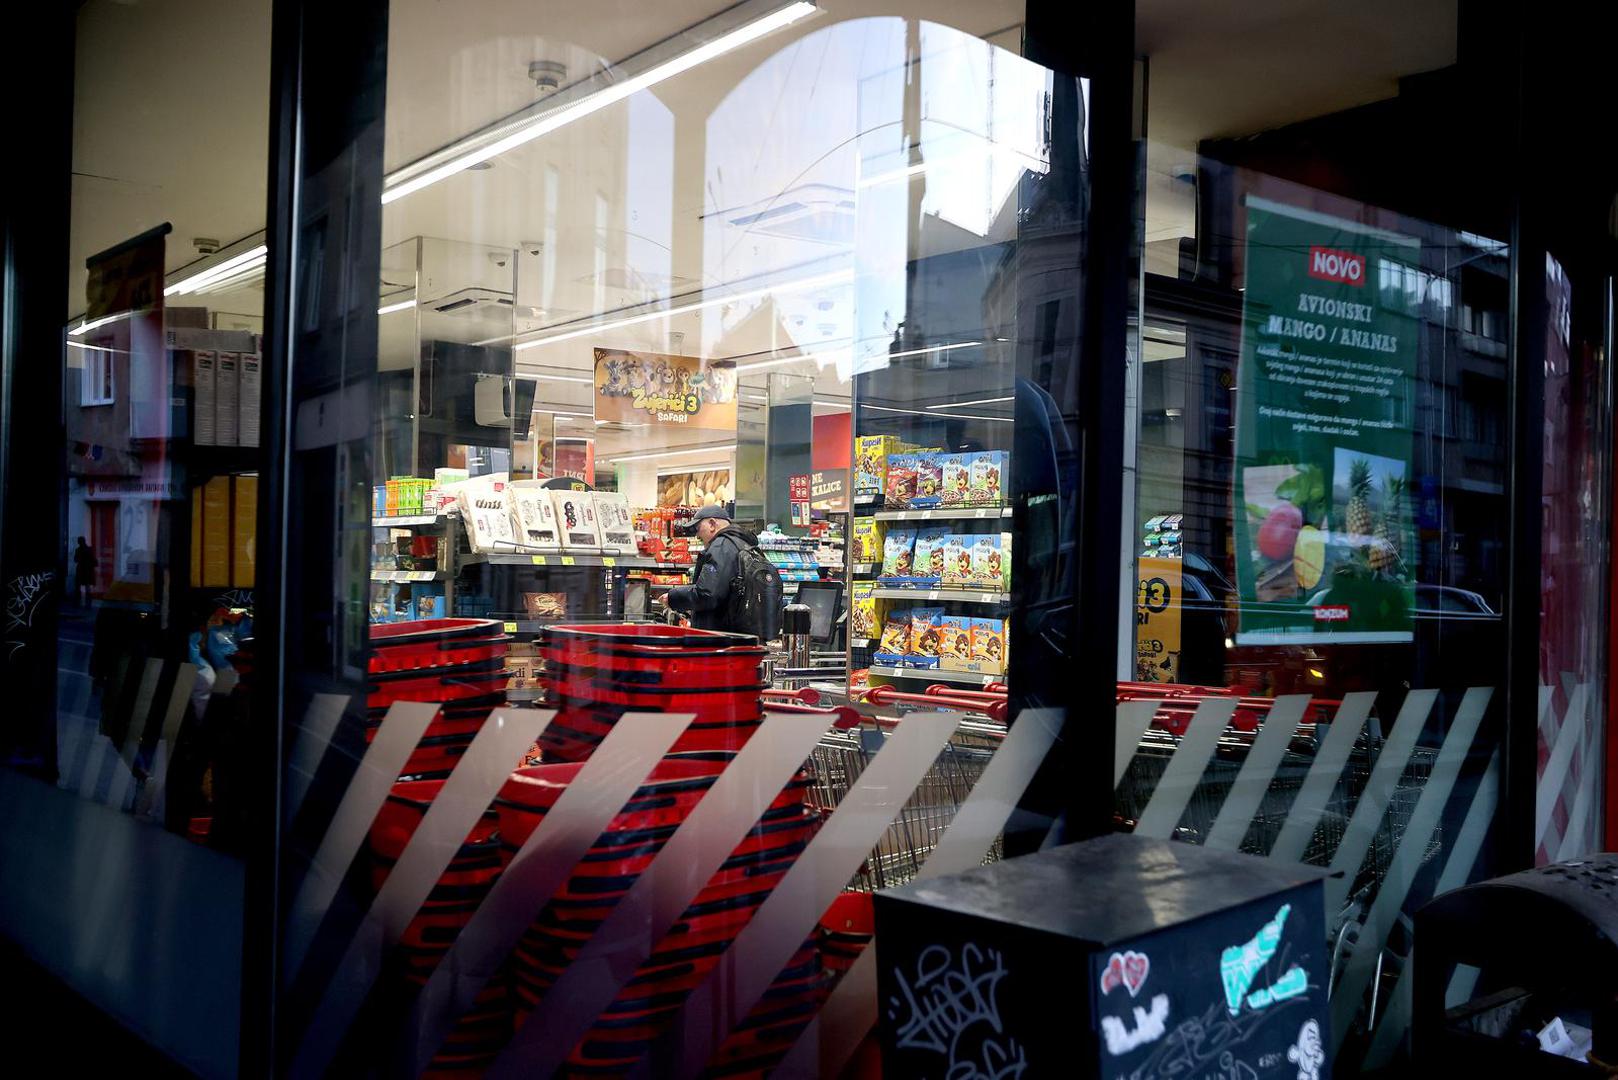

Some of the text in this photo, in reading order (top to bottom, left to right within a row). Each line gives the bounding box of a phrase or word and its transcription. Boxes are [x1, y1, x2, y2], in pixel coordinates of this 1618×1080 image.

[1313, 251, 1361, 280] NOVO
[1298, 293, 1373, 323] AVIONSKI
[1268, 314, 1326, 341] MANGO
[1340, 328, 1397, 353] ANANAS
